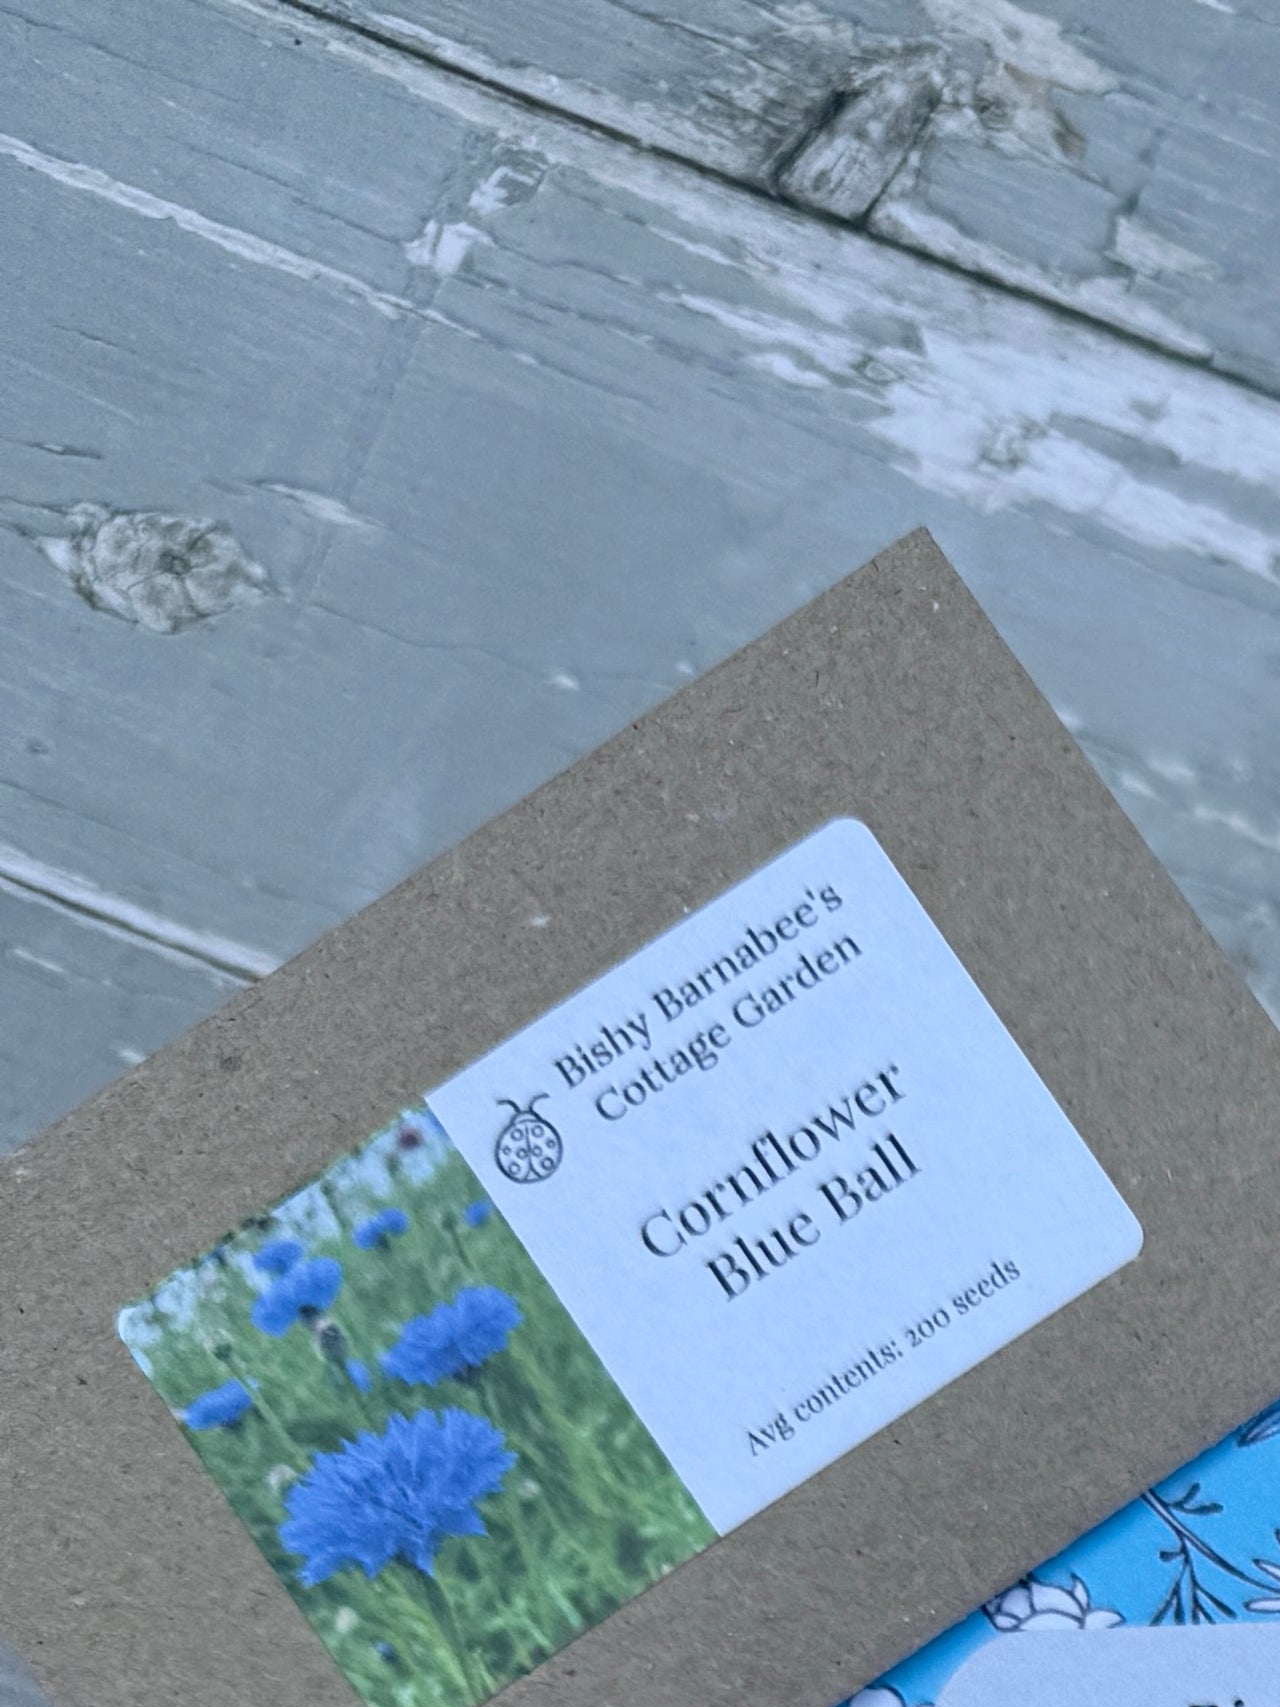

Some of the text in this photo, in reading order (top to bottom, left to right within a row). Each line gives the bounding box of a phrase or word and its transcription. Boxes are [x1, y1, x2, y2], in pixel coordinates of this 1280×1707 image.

[554, 881, 844, 1091] Bishy Barnabee's
[595, 931, 863, 1122] Cottage Garden
[640, 1061, 906, 1260] Cornflower
[705, 1133, 922, 1302] Blue Ball
[747, 1258, 1021, 1455] Avg contents: 200 seeds
